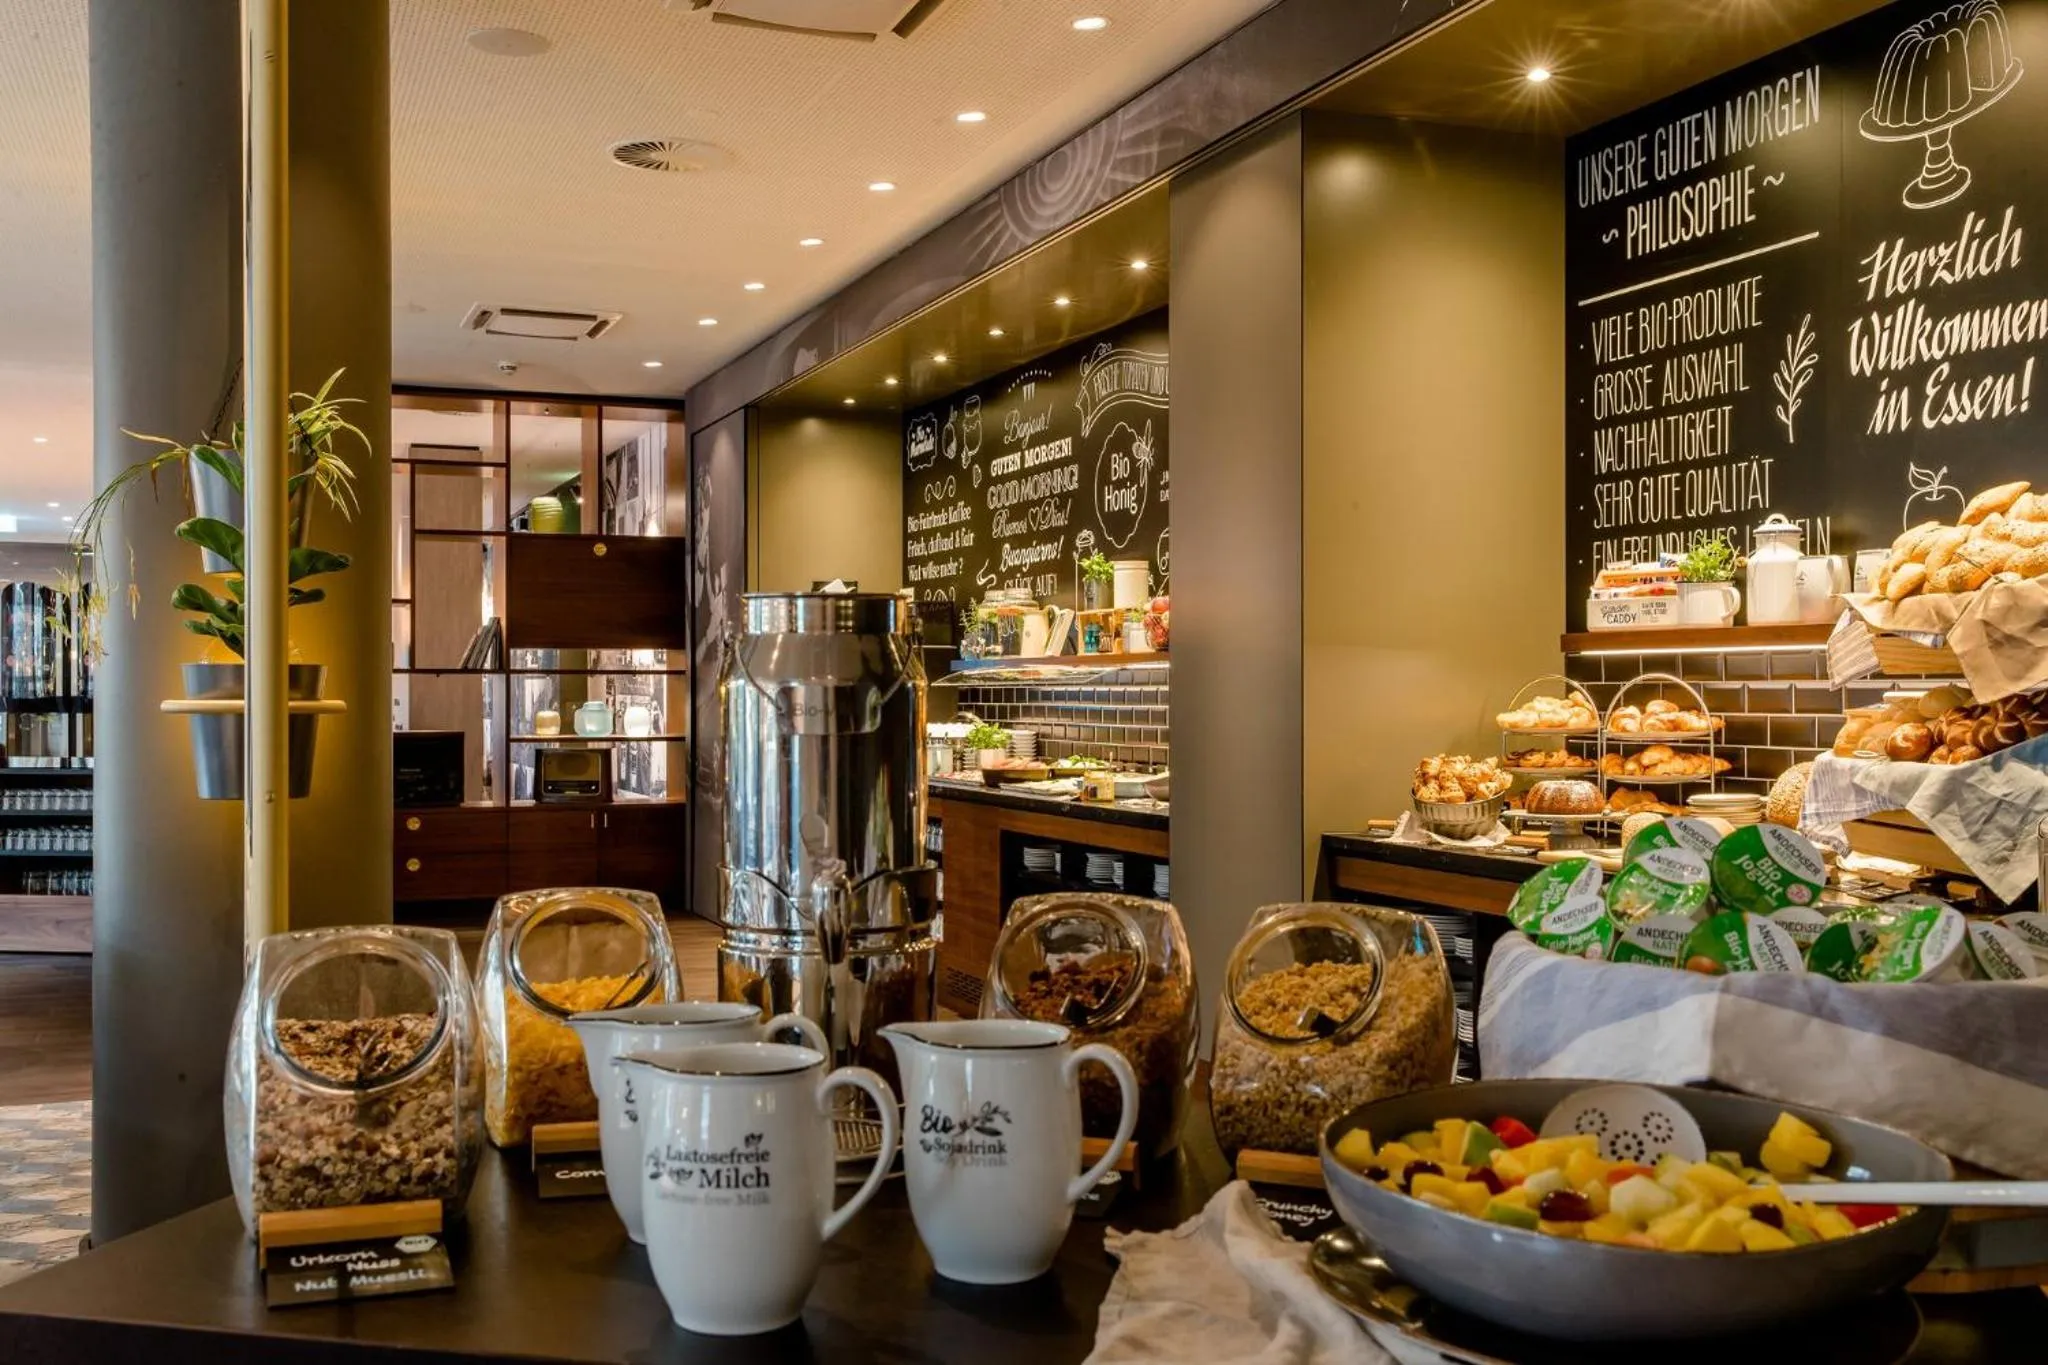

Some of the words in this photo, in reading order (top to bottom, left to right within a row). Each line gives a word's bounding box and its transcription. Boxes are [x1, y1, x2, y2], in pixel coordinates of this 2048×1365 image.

[1579, 133, 1649, 209] UNSERE
[1654, 105, 1717, 182] GUTEN
[1724, 64, 1820, 157] MORGEN
[1626, 164, 1757, 260] PHILOSOPHIE
[1857, 204, 2024, 302] Herzlich
[1592, 311, 1635, 366] VIELE
[1639, 275, 1763, 355] BIO-PRODUKTE
[1847, 297, 2048, 378] Willkommen
[1594, 364, 1653, 421] GROSSE
[1662, 342, 1750, 407] AUSWAHL
[1866, 377, 1912, 436] in
[1921, 355, 2035, 430] Essen!
[990, 451, 1021, 478] GUTEN
[1024, 436, 1073, 469] MORGEN!
[1111, 451, 1130, 481] Bio
[1594, 405, 1733, 476] NACHHALTIGKEIT
[1104, 481, 1138, 515] Honig
[1594, 479, 1634, 530] SEHR
[1638, 472, 1682, 525] GUTE
[1685, 455, 1774, 518] QUALITÄT
[1756, 856, 1782, 881] Bio
[920, 1103, 955, 1134] Bio
[698, 1165, 771, 1190] Milch
[1268, 1211, 1316, 1228] oney
